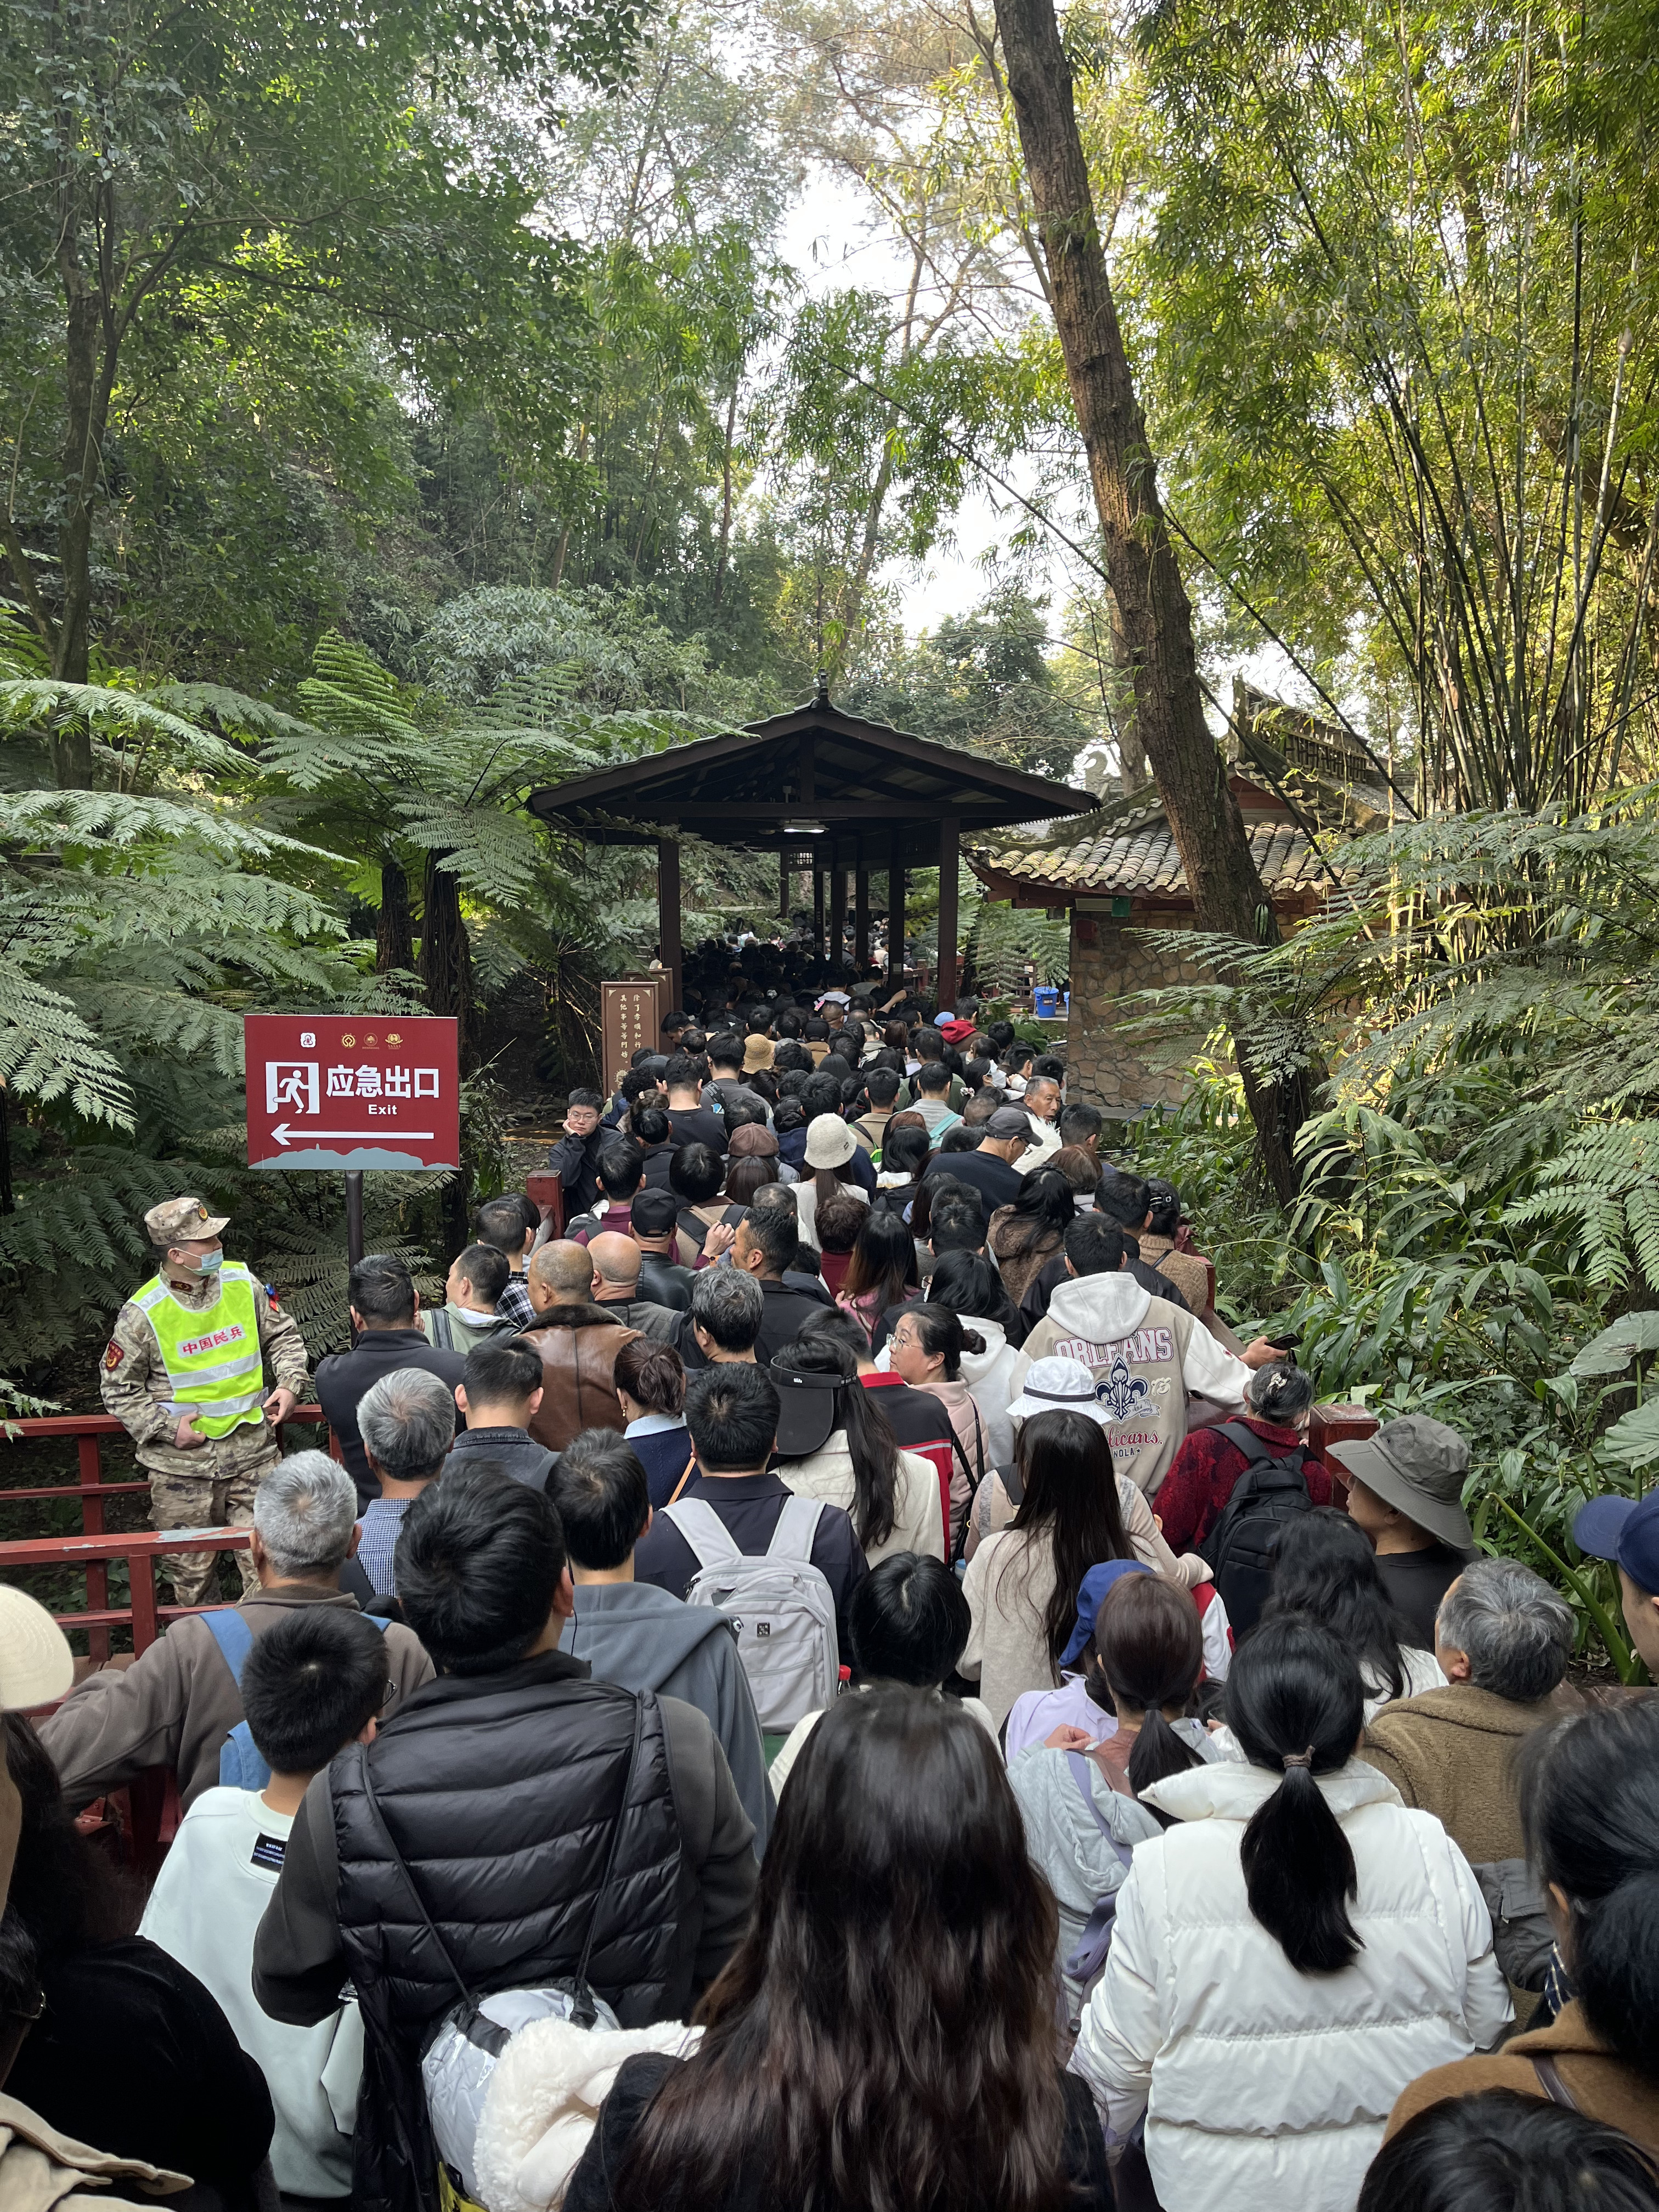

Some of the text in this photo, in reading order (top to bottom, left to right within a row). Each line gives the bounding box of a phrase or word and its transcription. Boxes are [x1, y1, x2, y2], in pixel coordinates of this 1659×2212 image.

[326, 1064, 439, 1098] 应急出口
[368, 1104, 397, 1115] Exit
[183, 1326, 242, 1355] 中国民兵
[1108, 1425, 1164, 1448] licans.
